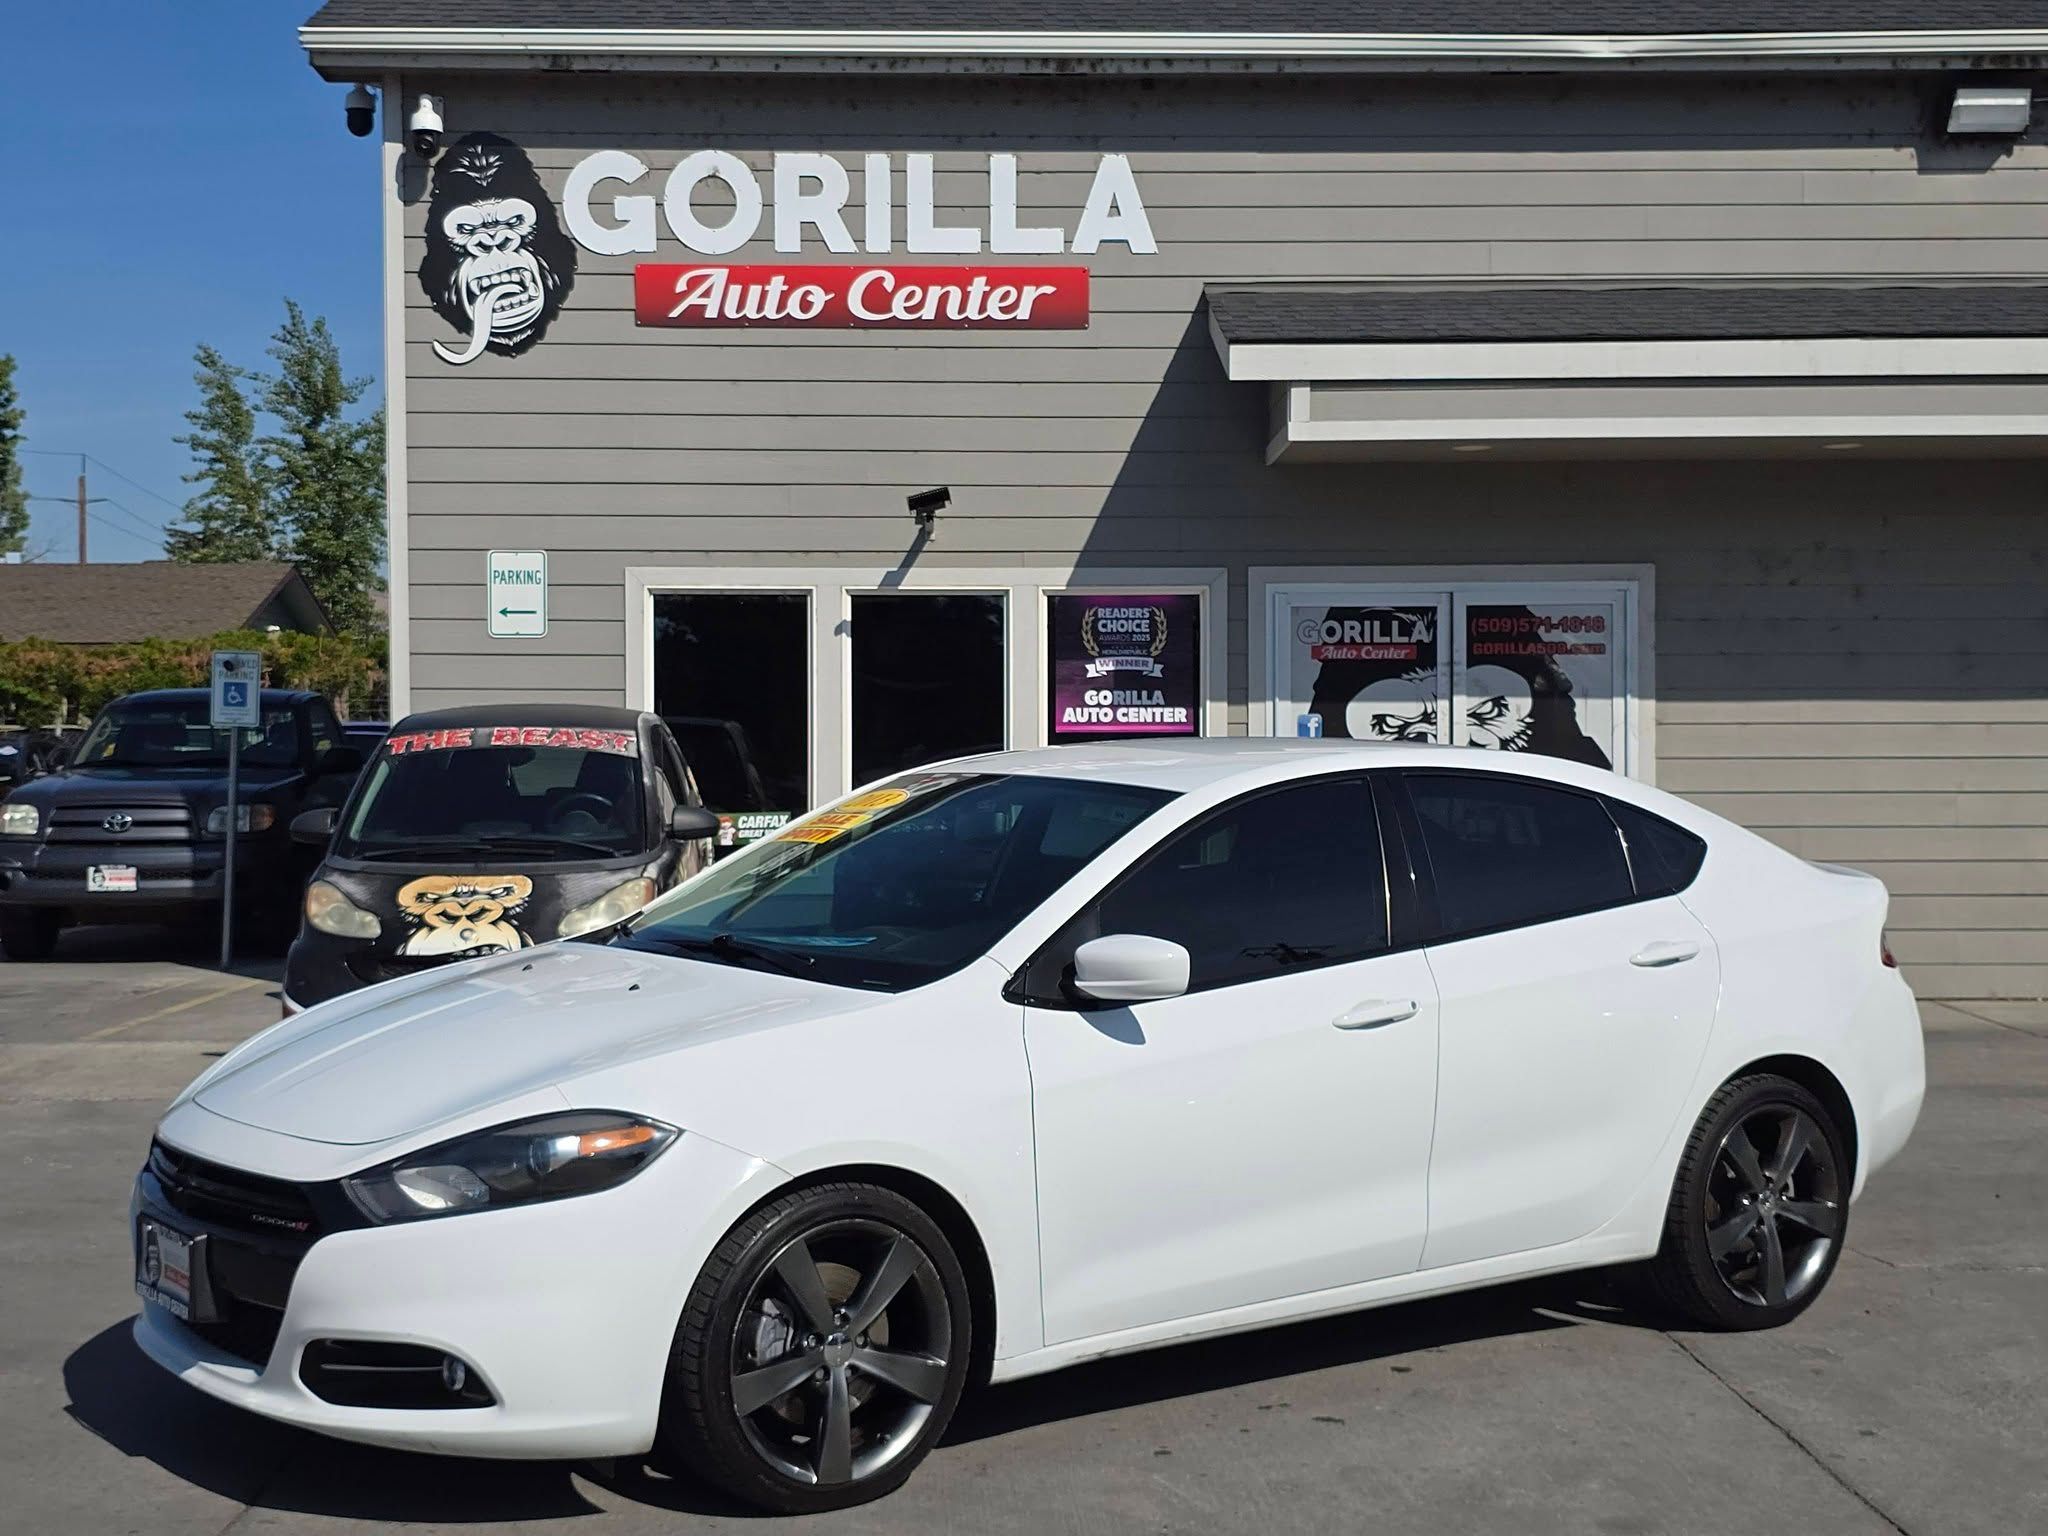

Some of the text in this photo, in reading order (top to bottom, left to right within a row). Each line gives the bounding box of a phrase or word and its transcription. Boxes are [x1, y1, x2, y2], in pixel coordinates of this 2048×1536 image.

[563, 150, 1158, 255] GORILLA
[667, 268, 1056, 321] Auto Center
[493, 569, 542, 585] PARKING
[1098, 619, 1150, 633] CHOICE
[1297, 619, 1428, 644] GORILLA
[1320, 645, 1411, 660] Auto Center
[1098, 659, 1150, 668] WINNER
[1084, 689, 1165, 706] GORILLA
[1062, 707, 1187, 723] AUTO CENTER
[386, 726, 637, 755] THE BEAST
[738, 815, 789, 829] CARFAX
[738, 829, 764, 838] GREAT
